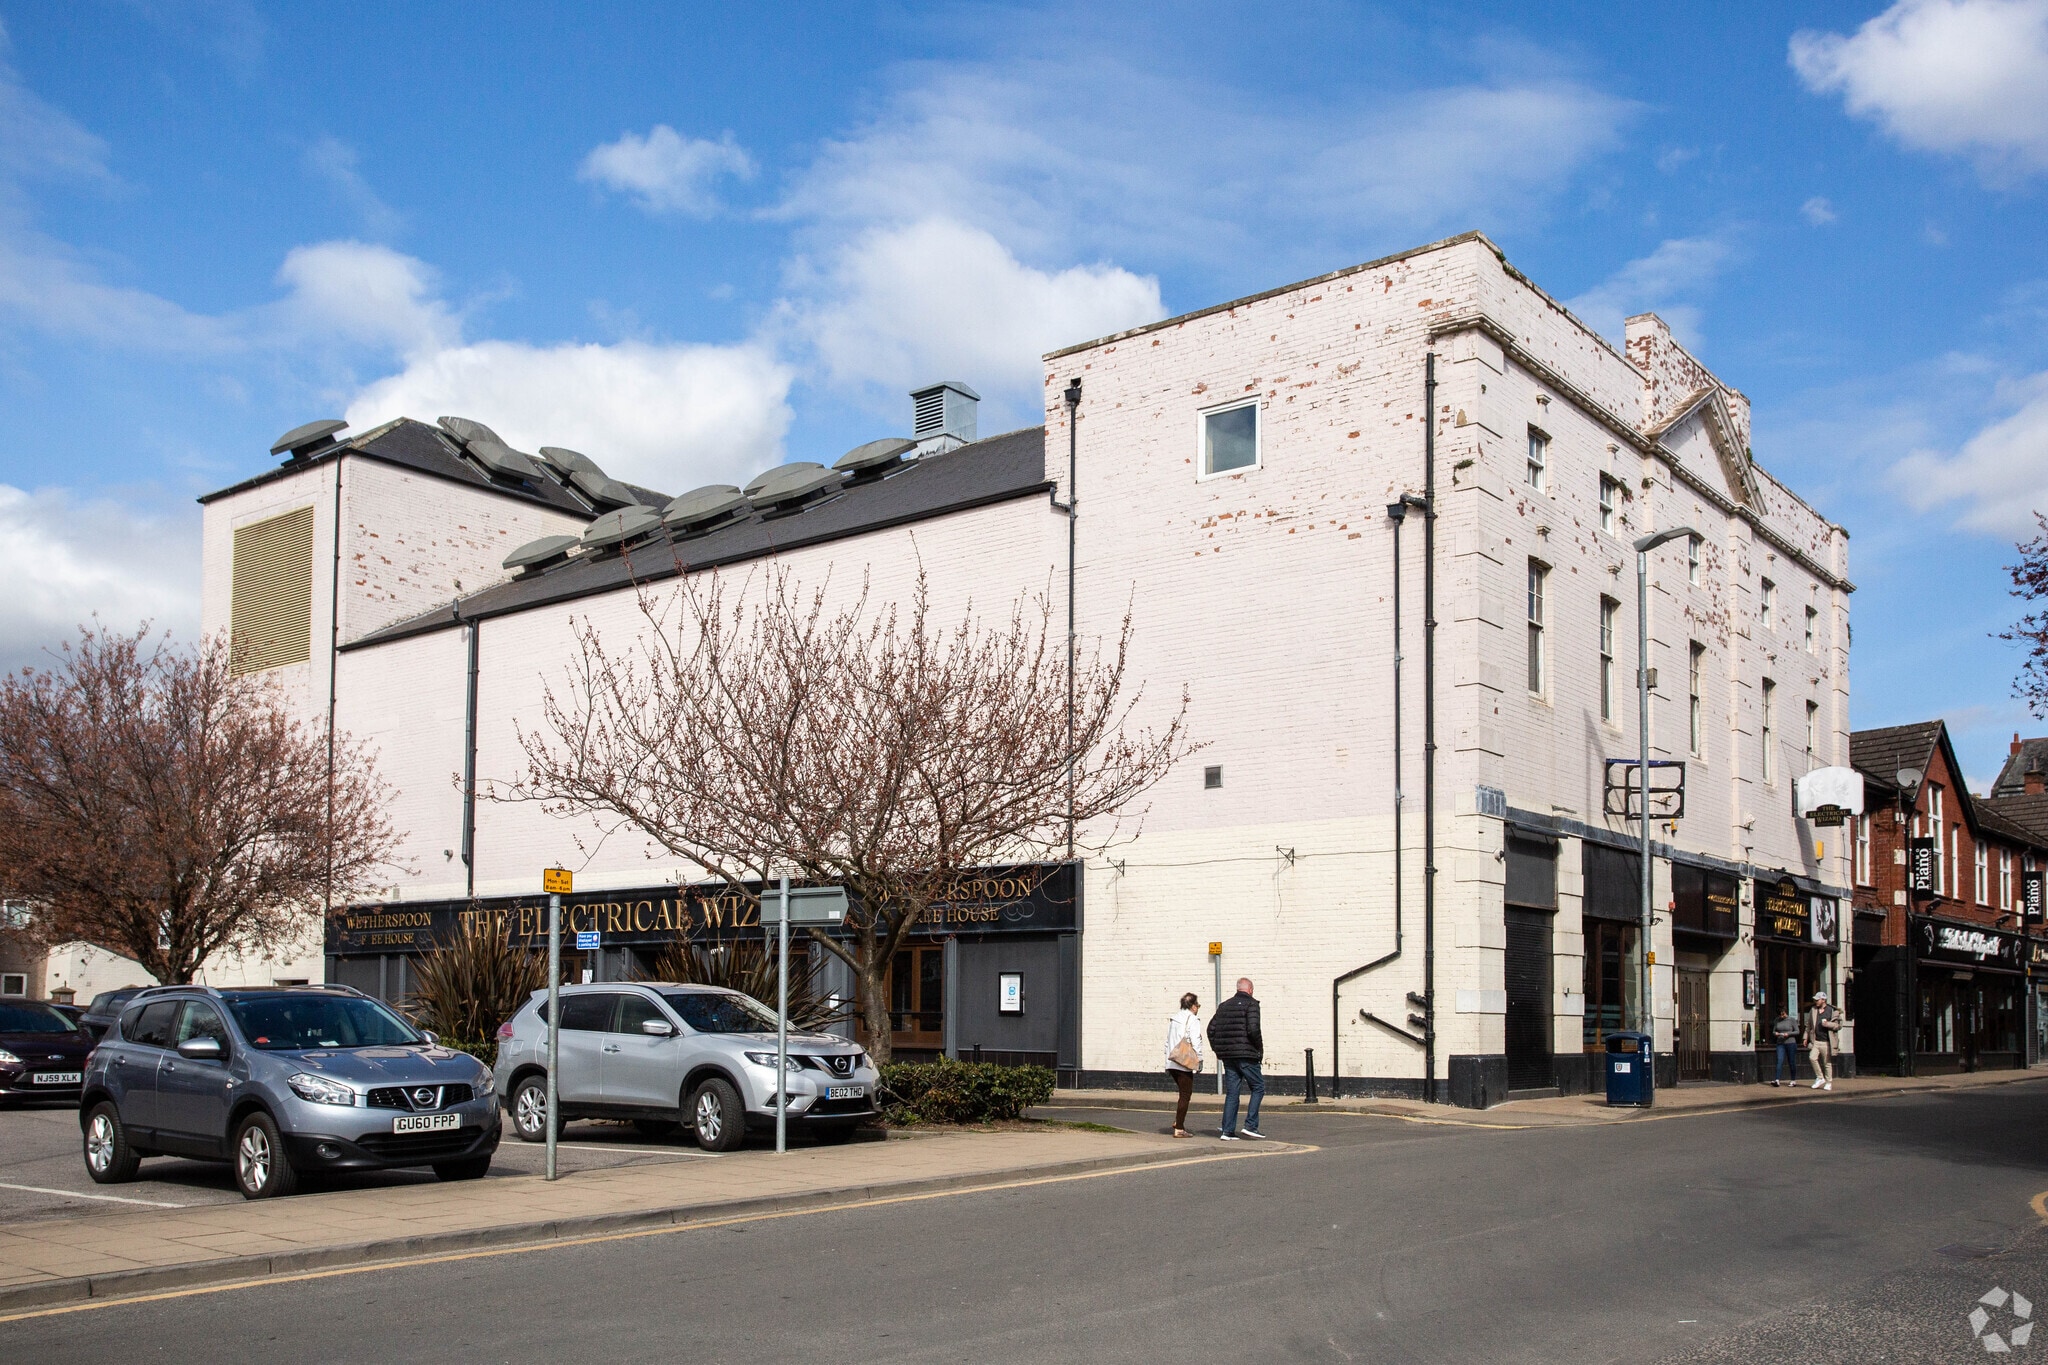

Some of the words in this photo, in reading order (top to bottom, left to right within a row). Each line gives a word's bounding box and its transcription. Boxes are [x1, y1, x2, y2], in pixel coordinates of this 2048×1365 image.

[1916, 848, 1930, 890] Piano
[2027, 879, 2040, 915] Piano
[702, 895, 761, 929] WIZ
[947, 907, 1000, 923] HOUSE
[346, 912, 432, 929] WETHERSPOON
[361, 933, 381, 945] FEE
[384, 932, 415, 945] HOUSE
[37, 1074, 60, 1082] NJ59
[61, 1074, 77, 1082] XLK
[830, 1088, 848, 1098] BE02
[399, 1117, 430, 1130] GU60
[434, 1115, 456, 1127] FPP
